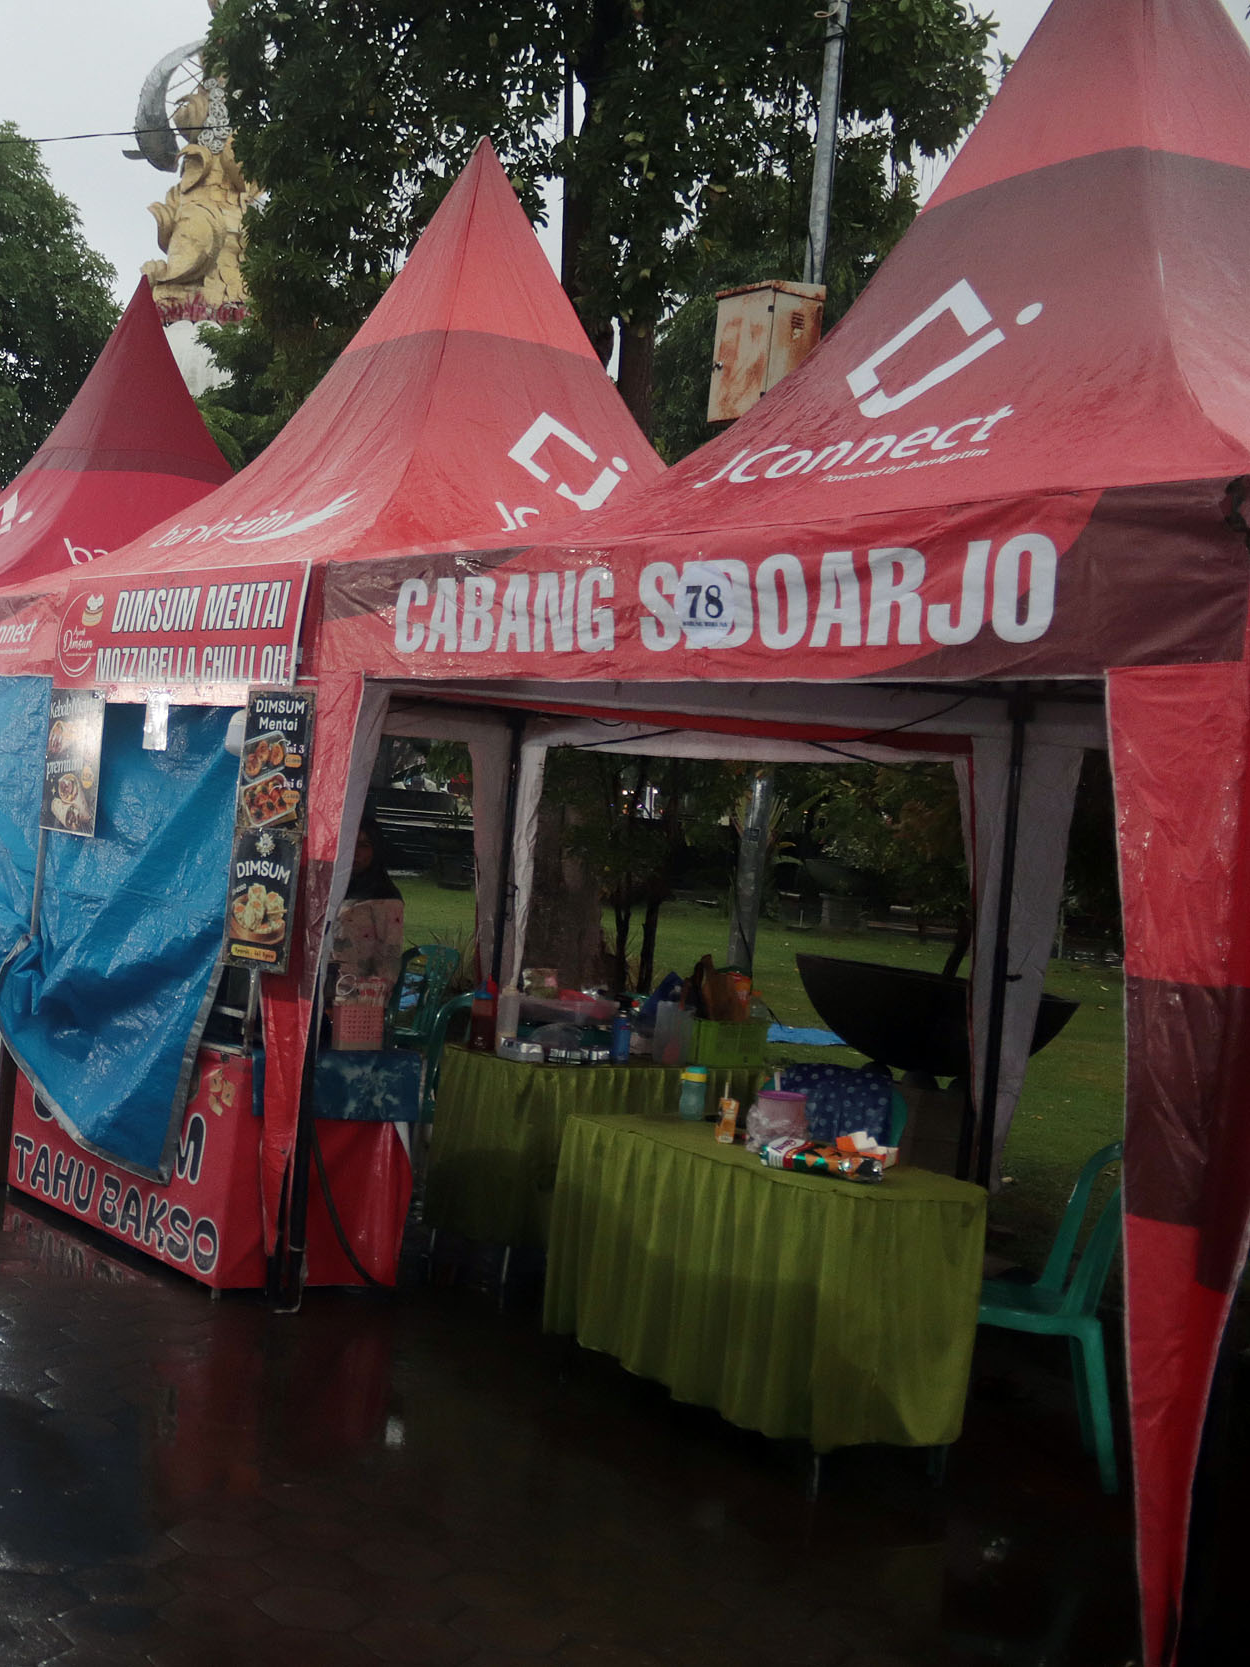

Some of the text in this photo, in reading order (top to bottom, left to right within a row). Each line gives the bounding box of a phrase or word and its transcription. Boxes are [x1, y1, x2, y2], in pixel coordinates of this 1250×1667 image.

[692, 404, 1014, 488] JConnect
[820, 466, 887, 483] Powered
[111, 580, 292, 633] DIMSUM MENTAI
[394, 533, 1057, 653] CABANG SDOARJO
[686, 584, 723, 618] 78
[63, 629, 93, 653] Dimsum
[200, 645, 257, 683] CHILLI
[255, 699, 306, 714] DIMSUM
[259, 716, 298, 731] Mentai
[236, 860, 291, 885] DIMSUM
[14, 1132, 97, 1214] TAHU
[98, 1173, 219, 1275] BAKSO
